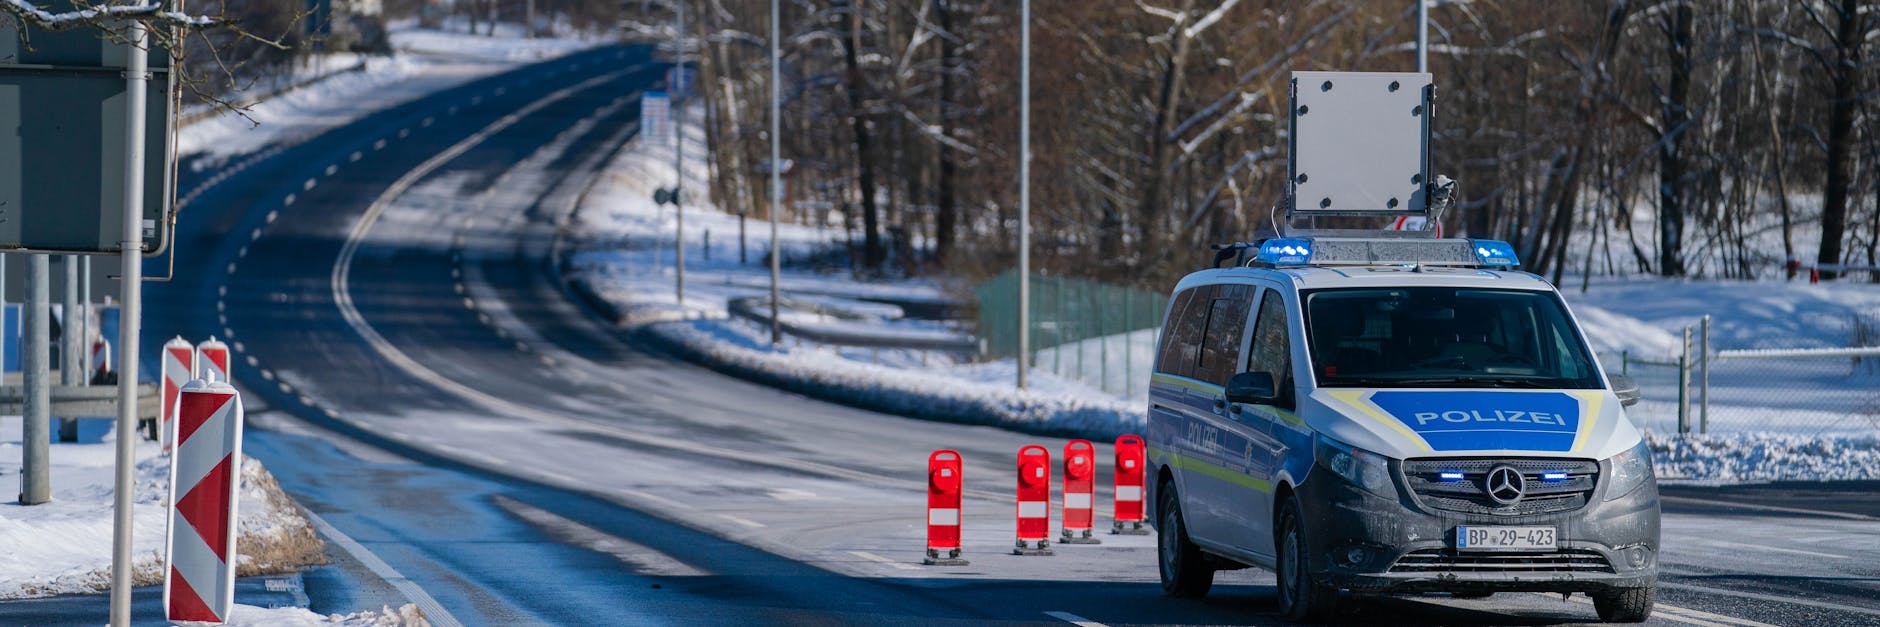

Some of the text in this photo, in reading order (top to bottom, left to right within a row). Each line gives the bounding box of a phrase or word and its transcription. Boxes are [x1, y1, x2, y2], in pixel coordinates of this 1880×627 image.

[1414, 410, 1567, 426] POLIZEI
[1187, 421, 1219, 456] POLIZEI
[1469, 529, 1554, 546] BP 29-423
